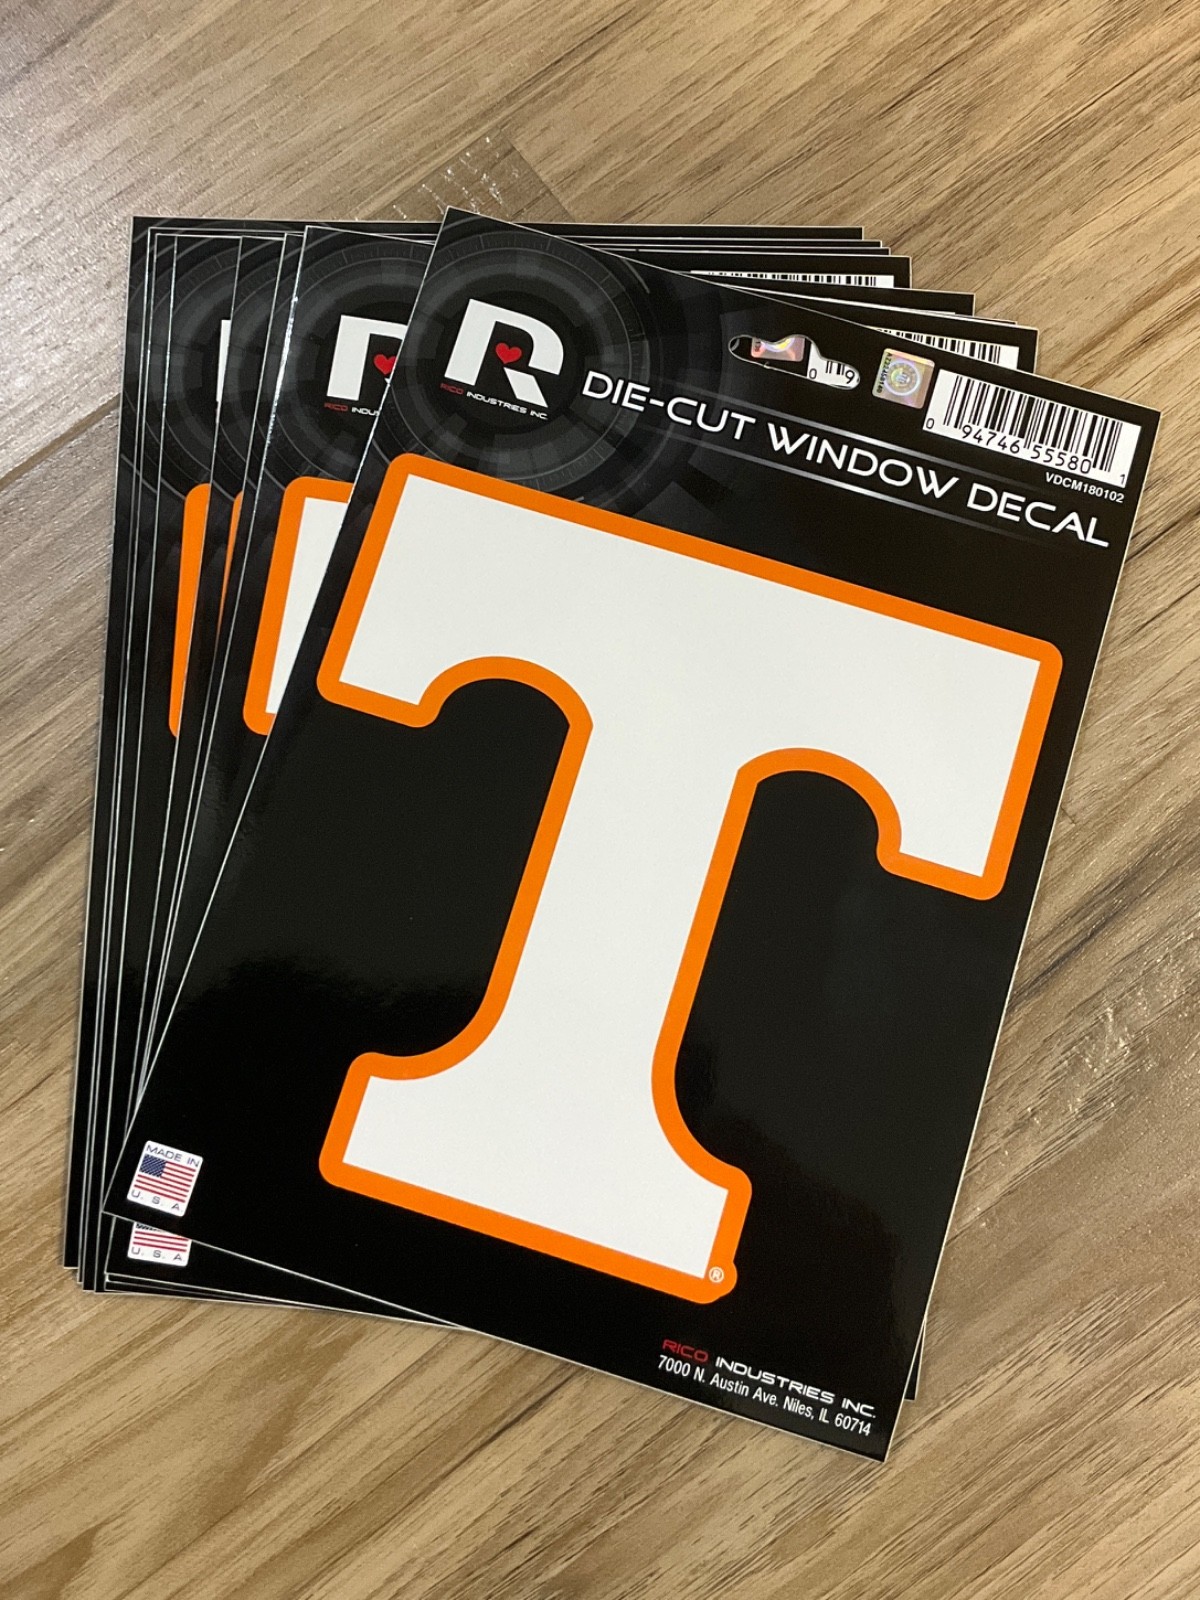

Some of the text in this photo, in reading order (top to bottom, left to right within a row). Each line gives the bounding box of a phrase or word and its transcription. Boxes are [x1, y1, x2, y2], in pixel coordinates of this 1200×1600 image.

[324, 403, 348, 412] RICO
[440, 383, 464, 395] RICO
[466, 391, 527, 414] INDUSTRIES
[582, 370, 1110, 547] DIE-CUT WINDOW DECAL
[925, 417, 1126, 485] 0 94746 55580 1
[1045, 471, 1125, 503] VDCM180102
[146, 1144, 200, 1168] MADE IN
[658, 1354, 872, 1437] 7000 N. Austin Ave. Niles, IL 60714
[661, 1339, 876, 1419] RICO INDUSTRIES INC.
